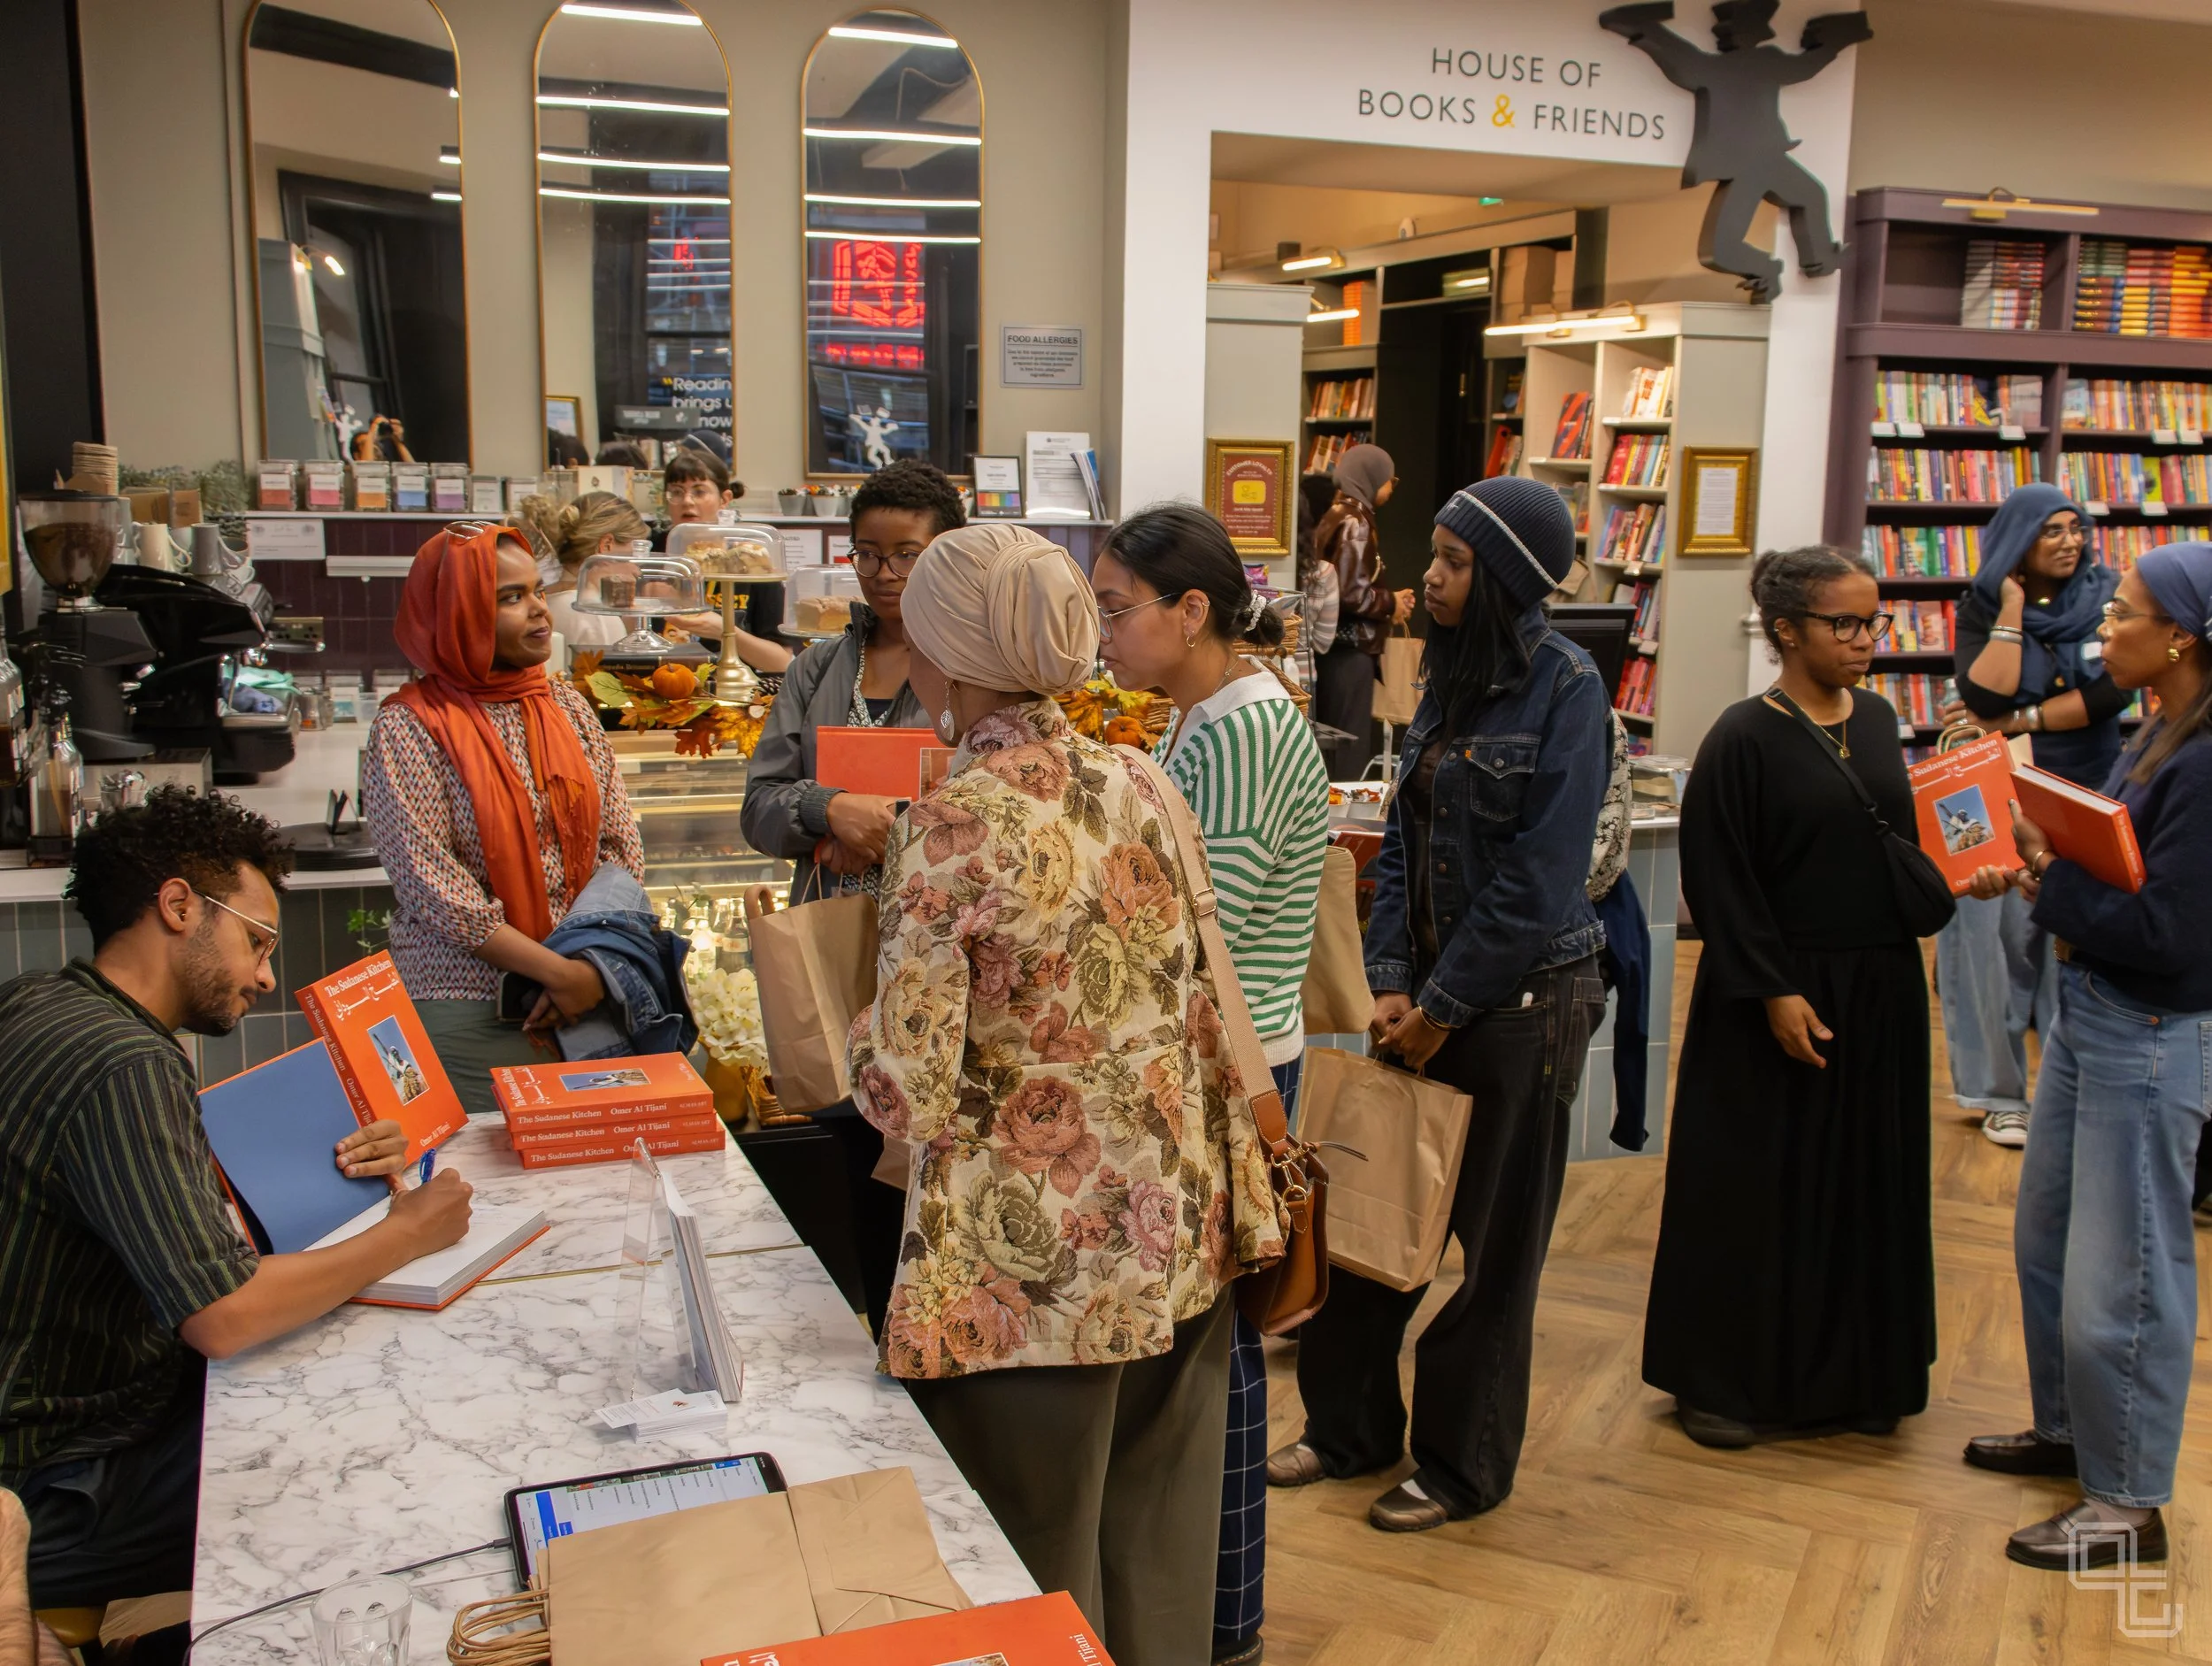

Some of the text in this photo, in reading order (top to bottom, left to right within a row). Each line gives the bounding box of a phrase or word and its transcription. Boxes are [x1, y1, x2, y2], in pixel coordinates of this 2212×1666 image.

[1432, 47, 1601, 88] HOUSE OF
[1358, 88, 1665, 140] BOOKS & FRIENDS
[1007, 334, 1079, 344] FOOD ALLERGIES
[672, 395, 722, 413] brings
[1913, 740, 1997, 777] Sudanese Kitchen
[324, 959, 392, 998] The Sudanese Kitchen
[305, 994, 316, 1010] The
[311, 1009, 333, 1045] Sudanese
[328, 1041, 346, 1071] Kitchen
[346, 1077, 361, 1099] Omer
[517, 1116, 534, 1125] The
[534, 1113, 570, 1123] Sudanese
[572, 1109, 602, 1119] Kitchen
[611, 1107, 632, 1116] Omer
[644, 1102, 667, 1113] Tijani
[521, 1134, 536, 1143] The
[538, 1131, 573, 1140] Sudanese
[575, 1128, 605, 1138] Kitchen
[613, 1125, 635, 1133] Omer
[636, 1123, 647, 1132] Al
[647, 1121, 670, 1132] Tijani
[531, 1154, 546, 1163] The
[548, 1150, 584, 1161] Sudanese
[585, 1148, 614, 1157] Kitchen
[657, 1140, 680, 1150] Tijani
[1069, 1632, 1097, 1663] Tijani
